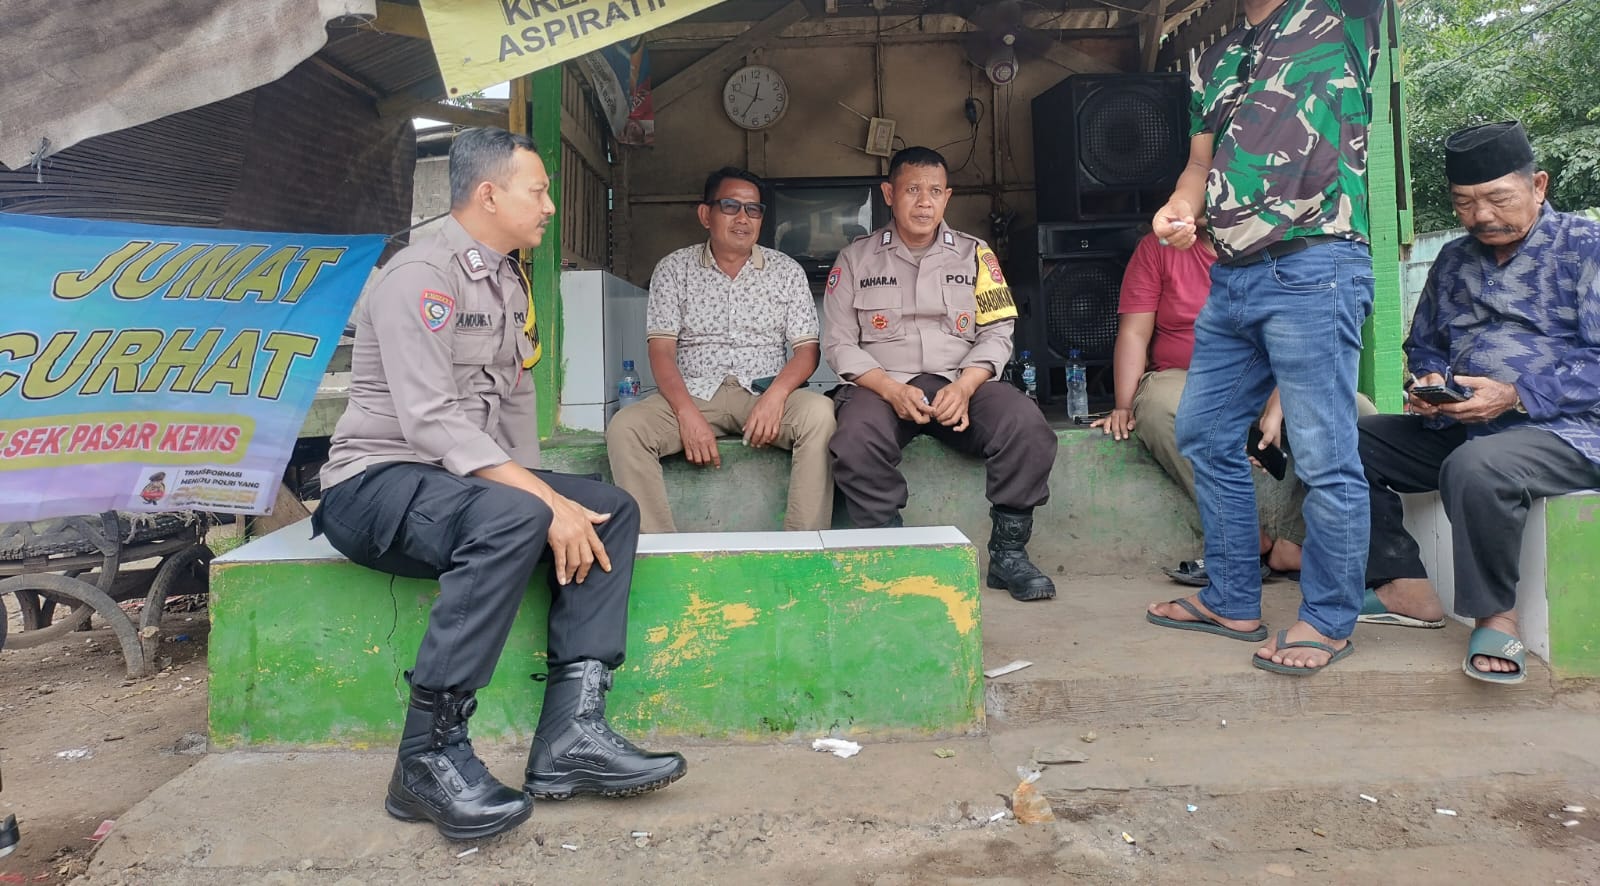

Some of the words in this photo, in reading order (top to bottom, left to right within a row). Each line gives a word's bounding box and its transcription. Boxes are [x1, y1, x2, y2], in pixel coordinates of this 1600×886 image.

[741, 73, 747, 83] 11
[751, 71, 761, 79] 12
[772, 81, 780, 91] 2
[775, 93, 783, 102] 3
[752, 117, 759, 126] 6
[52, 240, 349, 303] JUMAT
[860, 276, 897, 288] KAHAR.M
[0, 328, 319, 400] CURHAT
[66, 422, 154, 453] PASAR
[159, 423, 242, 452] KEMIS
